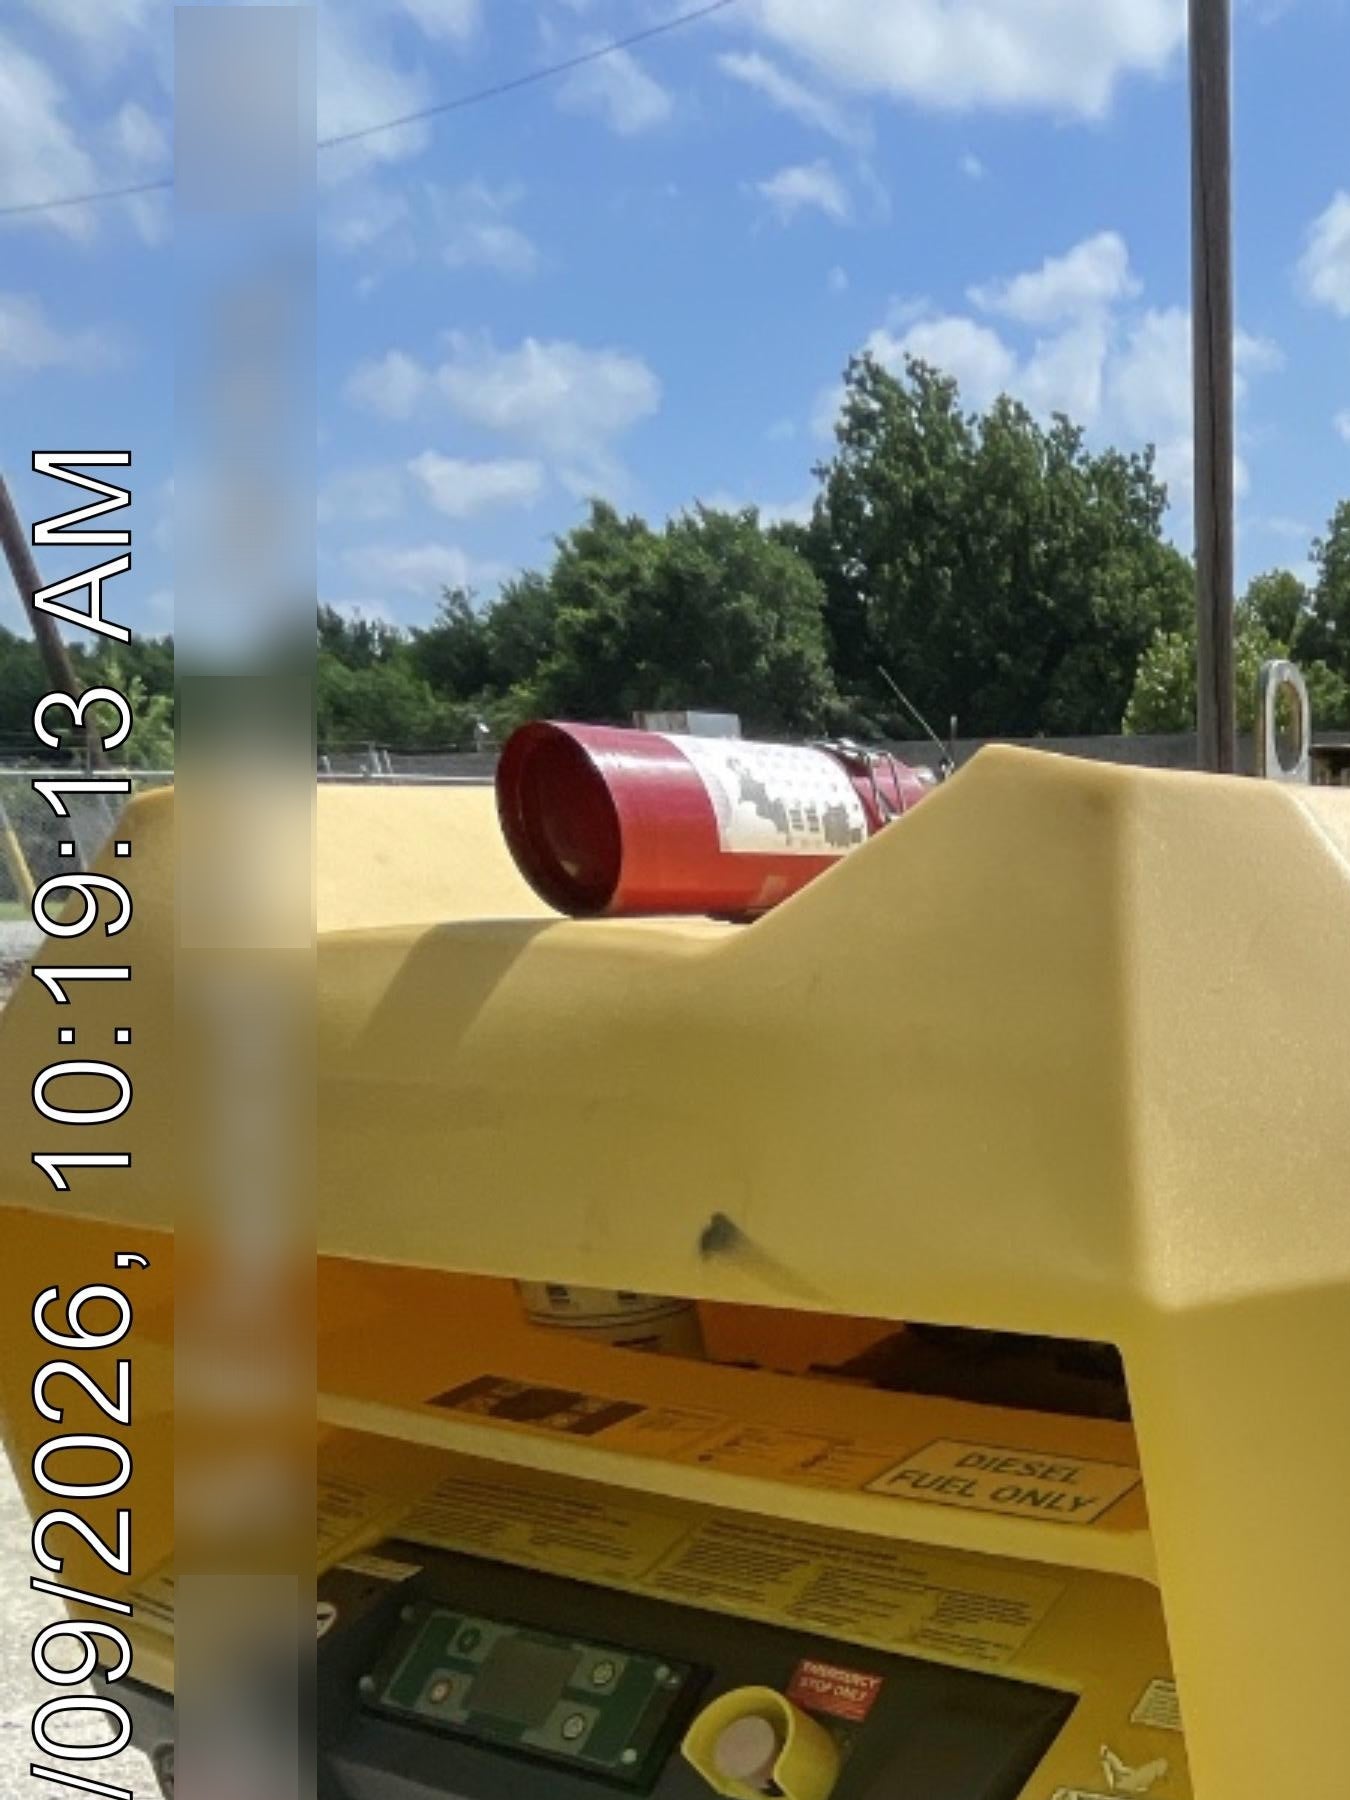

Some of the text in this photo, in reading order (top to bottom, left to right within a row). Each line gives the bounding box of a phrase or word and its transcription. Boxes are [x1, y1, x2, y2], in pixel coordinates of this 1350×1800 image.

[954, 1450, 1082, 1486] DIESEL
[886, 1468, 1100, 1513] FUEL ONLY
